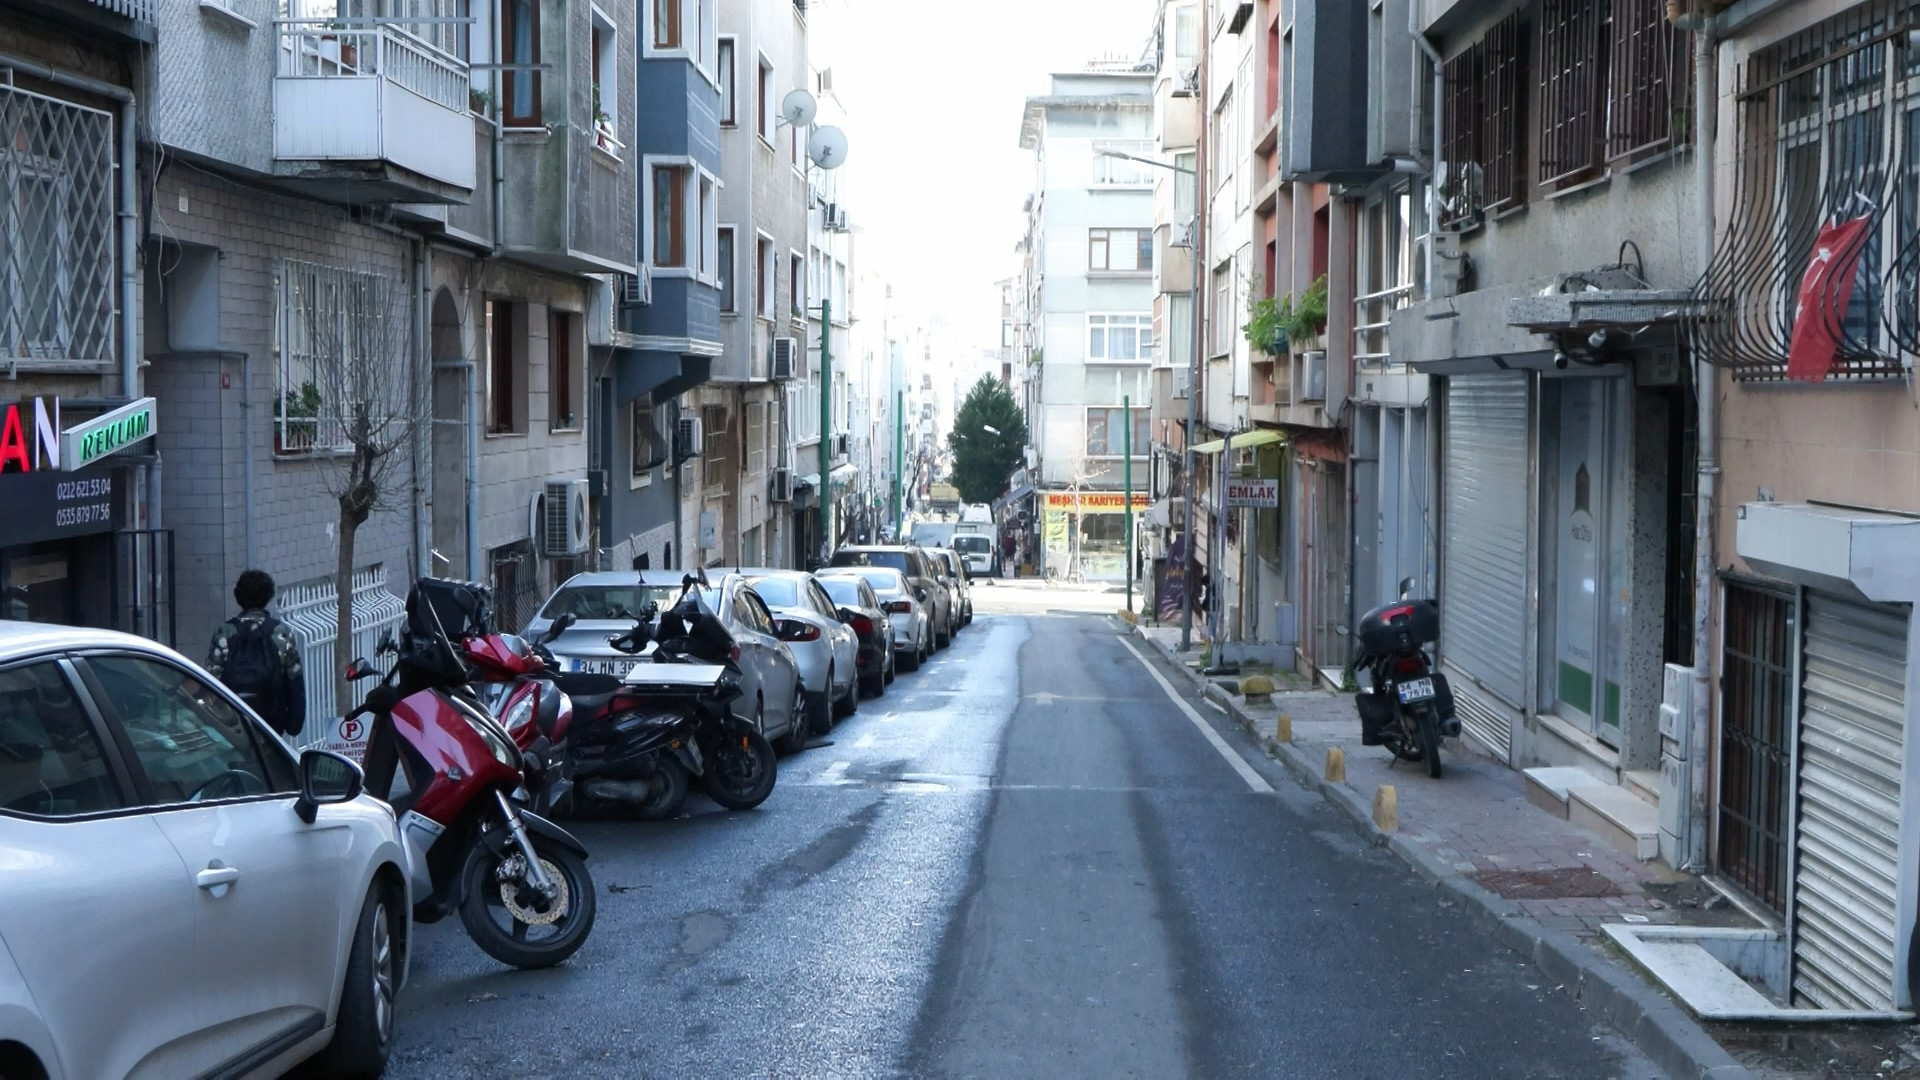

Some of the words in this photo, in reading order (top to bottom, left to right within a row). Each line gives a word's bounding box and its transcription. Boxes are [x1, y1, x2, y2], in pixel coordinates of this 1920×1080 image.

[80, 410, 150, 463] REKLAM
[57, 482, 76, 500] 0212
[76, 480, 89, 498] 621
[101, 478, 111, 495] 04
[1229, 486, 1275, 499] EMLAK
[1049, 494, 1086, 507] MEŞHR
[76, 505, 90, 524] 879
[91, 504, 99, 522] 77
[580, 660, 595, 674] 34
